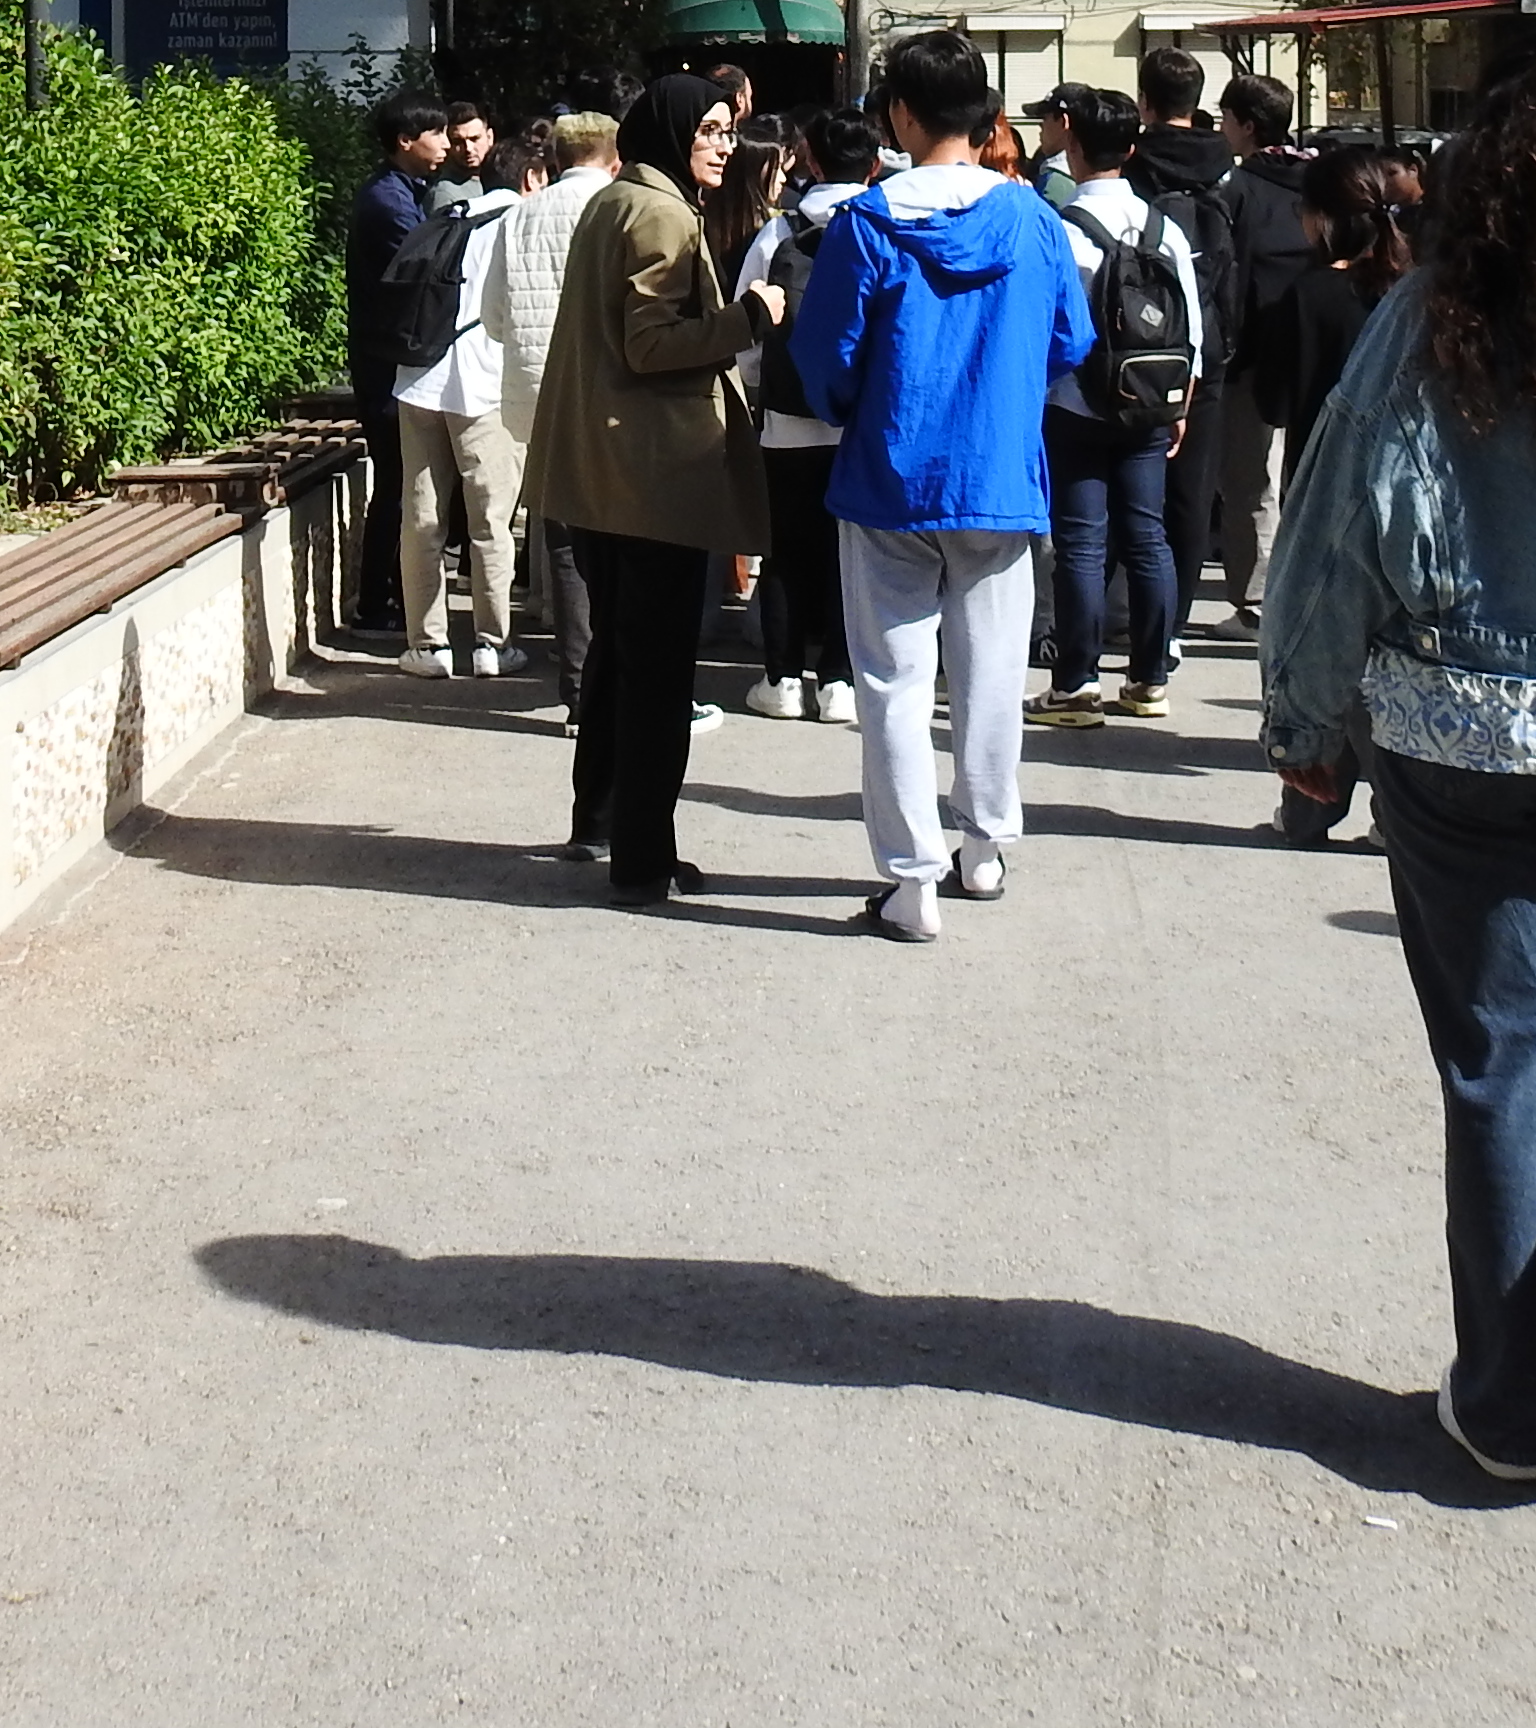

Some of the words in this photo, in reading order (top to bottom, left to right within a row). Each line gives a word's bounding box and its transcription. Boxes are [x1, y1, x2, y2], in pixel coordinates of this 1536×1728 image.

[234, 15, 276, 30] yapın,
[167, 35, 214, 48] zaman
[219, 32, 277, 47] kazanın!
